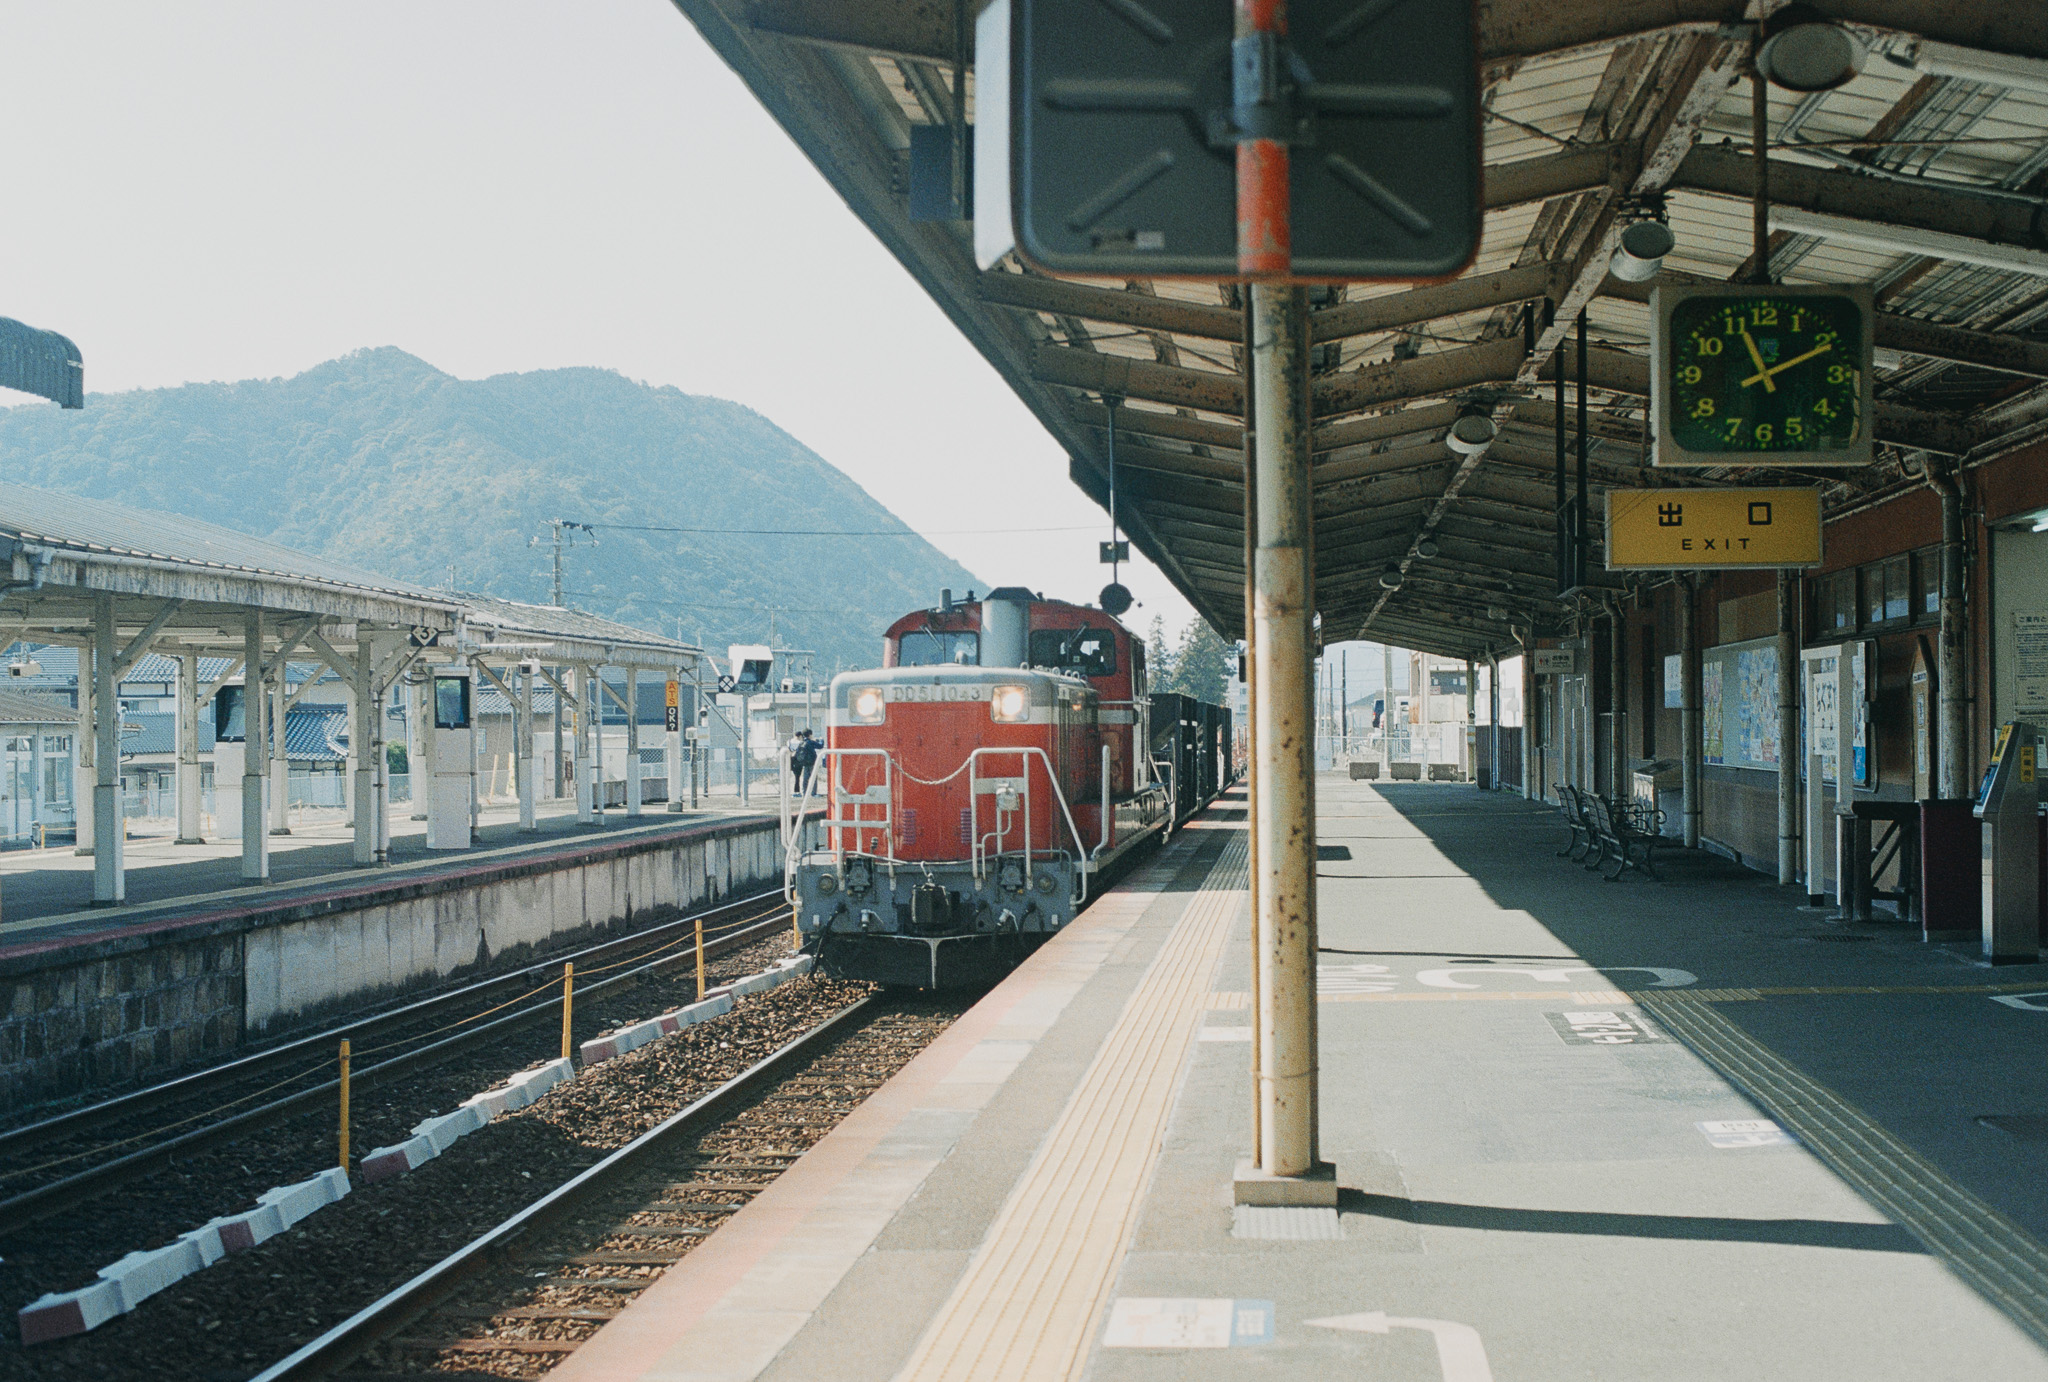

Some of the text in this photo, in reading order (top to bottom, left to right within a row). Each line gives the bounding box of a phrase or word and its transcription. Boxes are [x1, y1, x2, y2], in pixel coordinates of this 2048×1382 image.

[1725, 316, 1747, 334] 11
[1752, 307, 1778, 326] 12
[1791, 314, 1802, 332] 1
[1698, 337, 1723, 356] 10
[1814, 333, 1832, 352] 2
[1685, 366, 1701, 384] 9
[1827, 365, 1844, 384] 3
[1698, 398, 1715, 417] 8
[1814, 398, 1830, 416] 4
[1726, 418, 1742, 436] 7
[1755, 423, 1773, 442] 6
[1786, 417, 1802, 436] 5
[1658, 502, 1772, 527] 出口
[1682, 538, 1750, 550] EXIT
[420, 627, 430, 639] 3
[668, 682, 676, 731] ATS OK?
